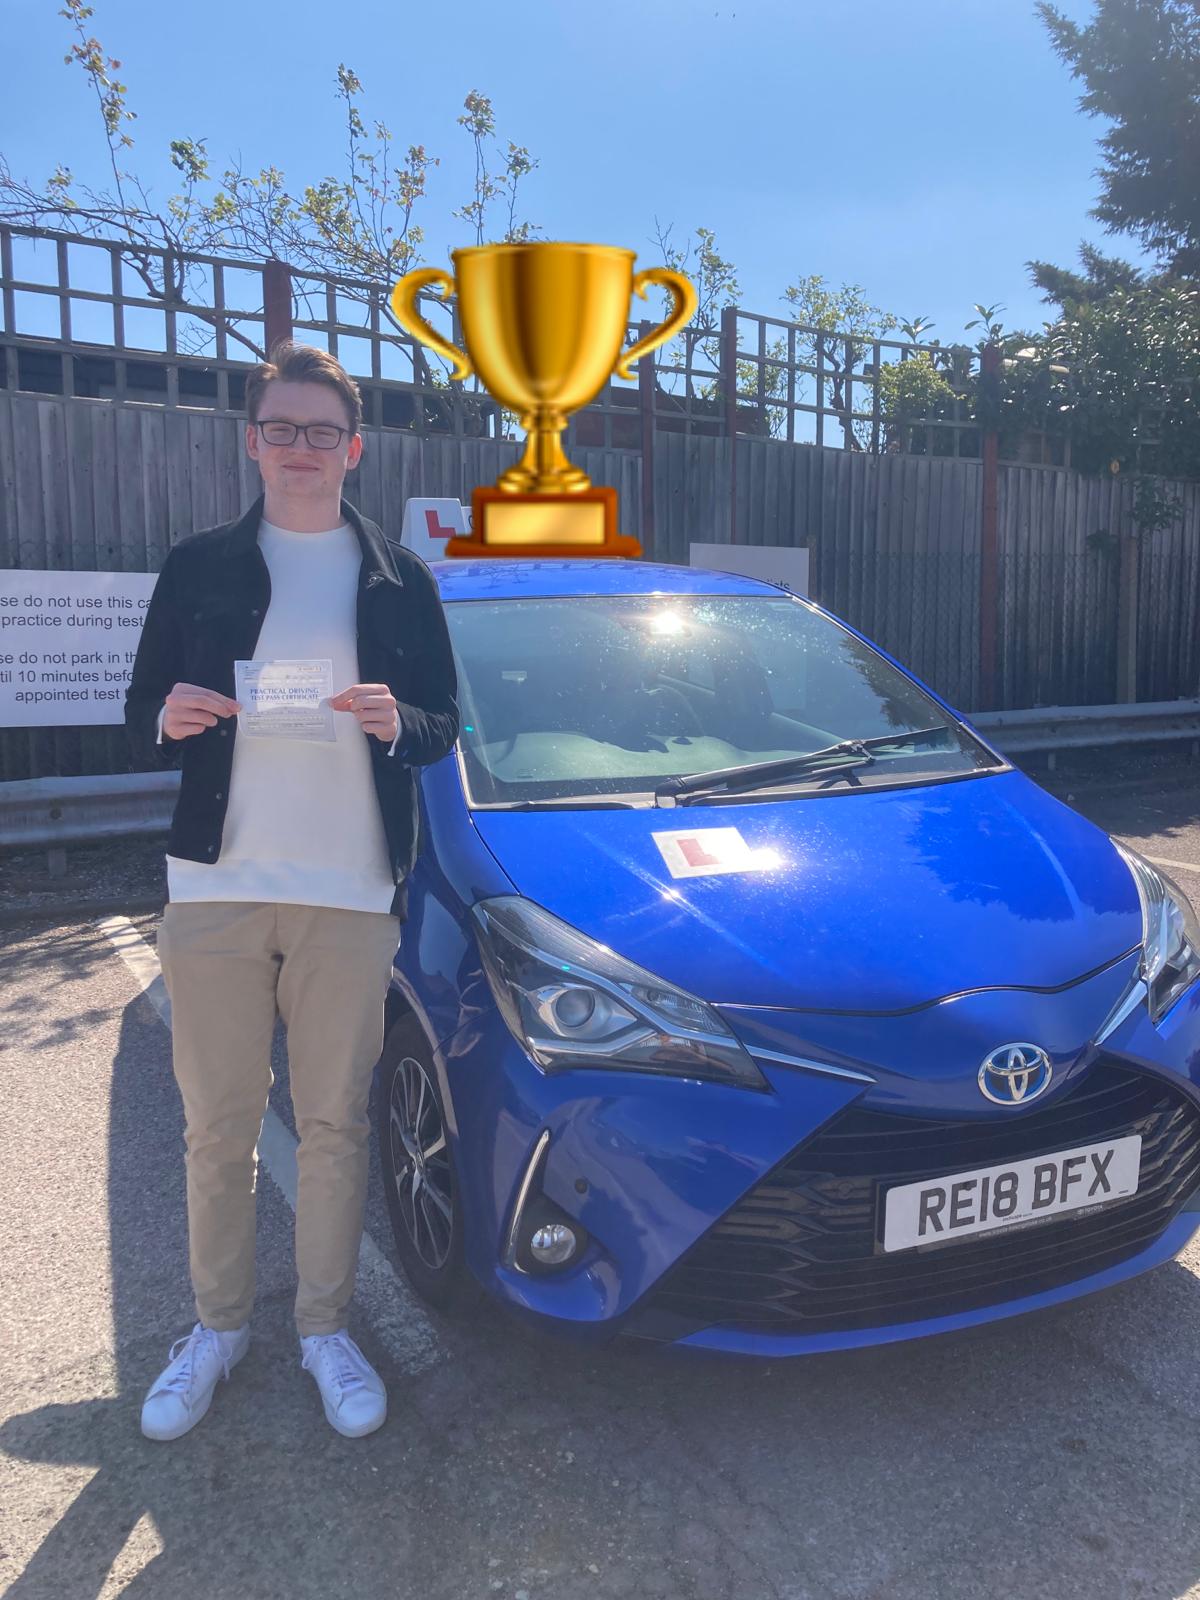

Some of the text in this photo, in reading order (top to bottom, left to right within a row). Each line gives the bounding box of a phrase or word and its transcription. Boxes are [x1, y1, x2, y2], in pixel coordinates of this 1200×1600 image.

[425, 510, 456, 539] L
[24, 595, 43, 608] do
[48, 597, 72, 608] not
[76, 599, 103, 609] use
[108, 596, 133, 609] this
[2, 614, 62, 628] practice
[67, 614, 113, 630] during
[19, 652, 38, 664] do
[43, 653, 67, 664] not
[71, 652, 103, 666] park
[108, 652, 120, 664] in
[18, 671, 36, 683] 10
[41, 670, 99, 683] minutes
[15, 688, 120, 704] appointed test
[917, 1149, 1115, 1236] RE18 BFX
